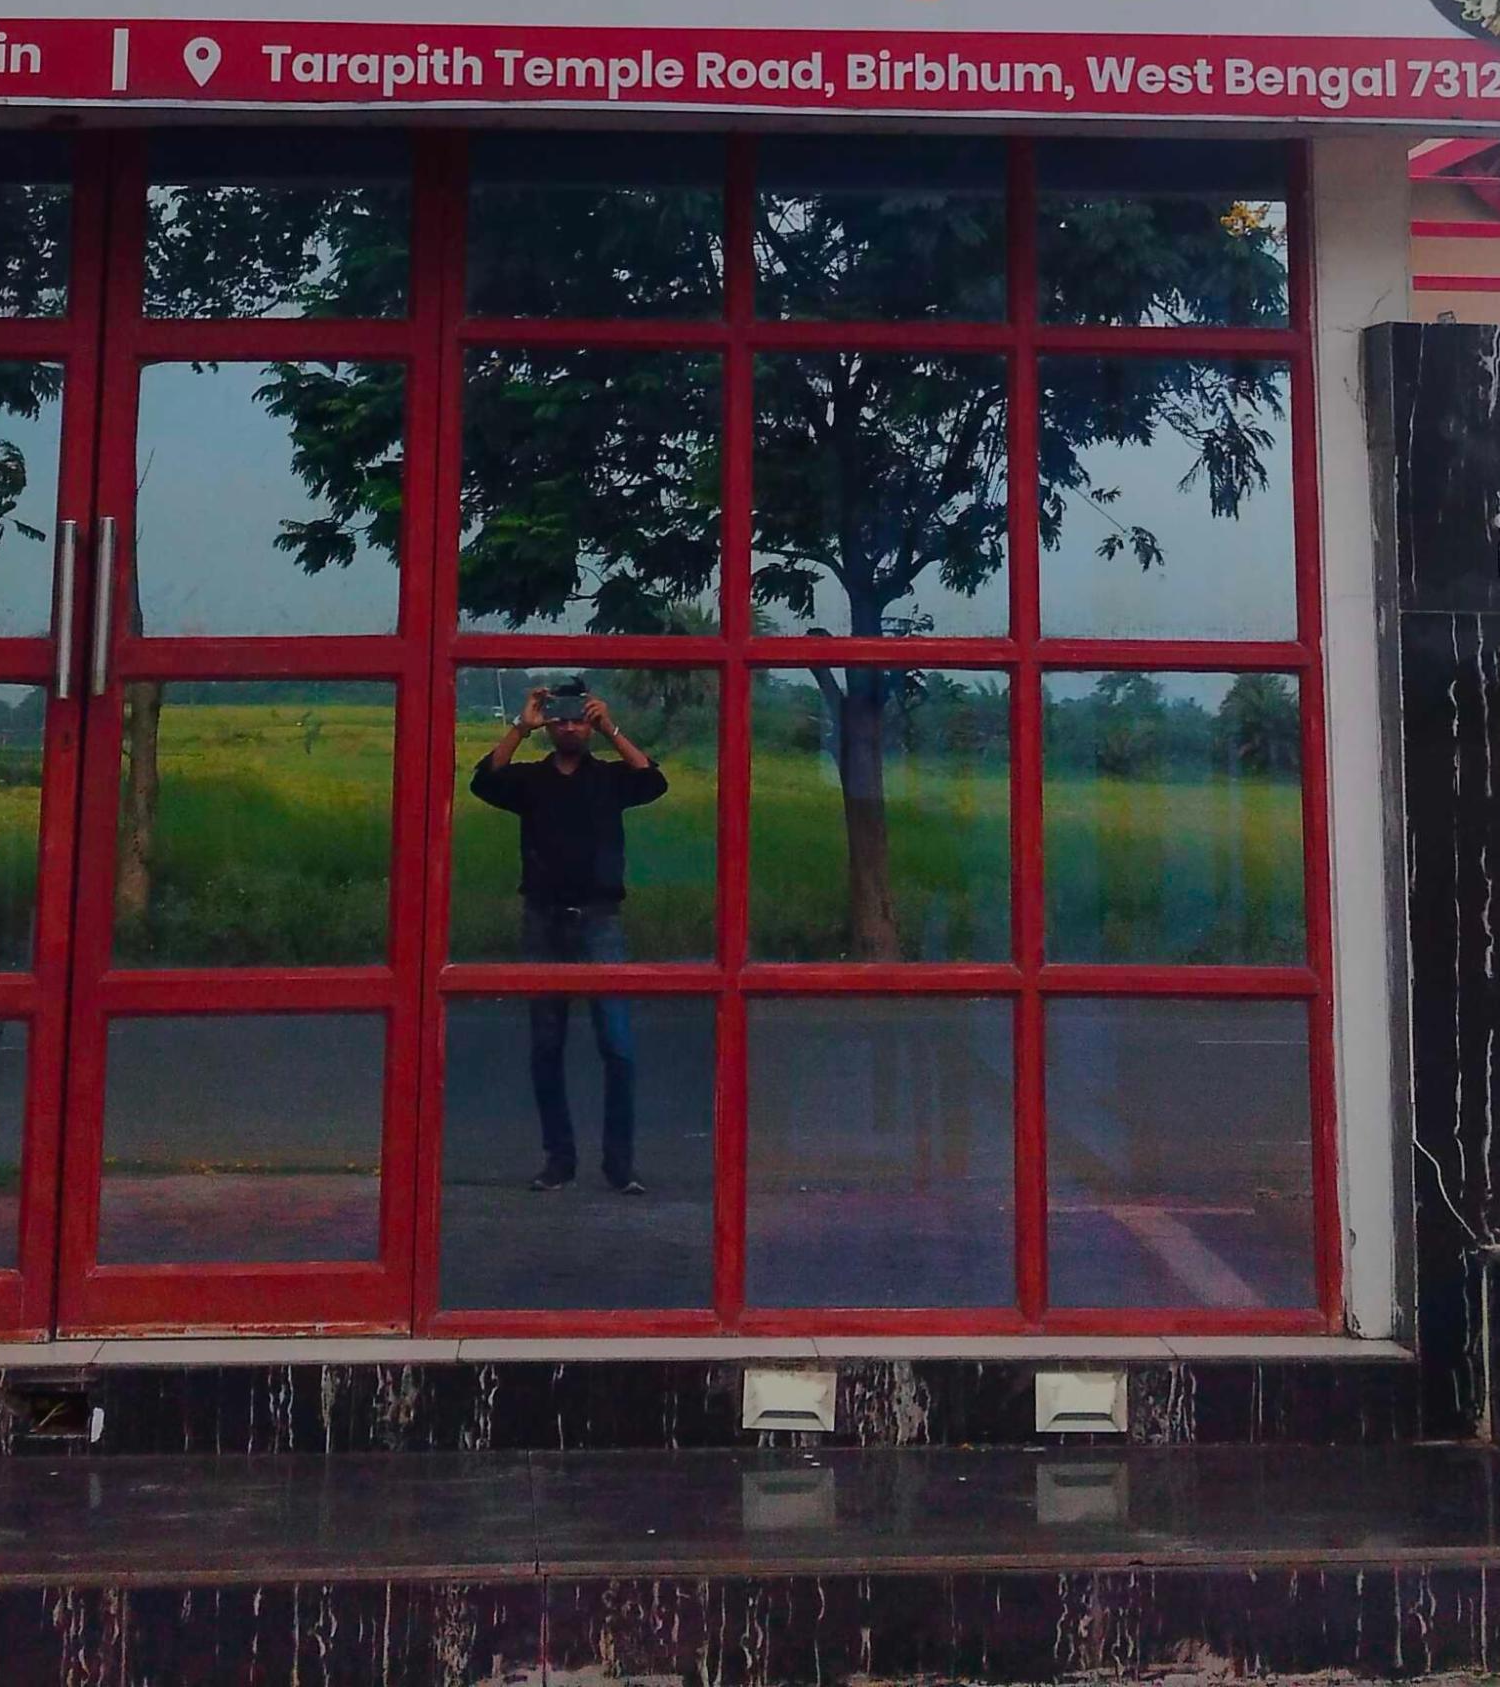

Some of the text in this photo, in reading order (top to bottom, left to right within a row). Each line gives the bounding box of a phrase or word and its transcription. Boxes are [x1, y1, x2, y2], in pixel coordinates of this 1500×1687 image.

[261, 43, 483, 98] Tarapith
[494, 49, 685, 101] Temple
[697, 51, 835, 99] Road,
[847, 50, 1075, 101] Birbhum,
[1086, 56, 1213, 95] West
[1225, 58, 1397, 109] Bengal
